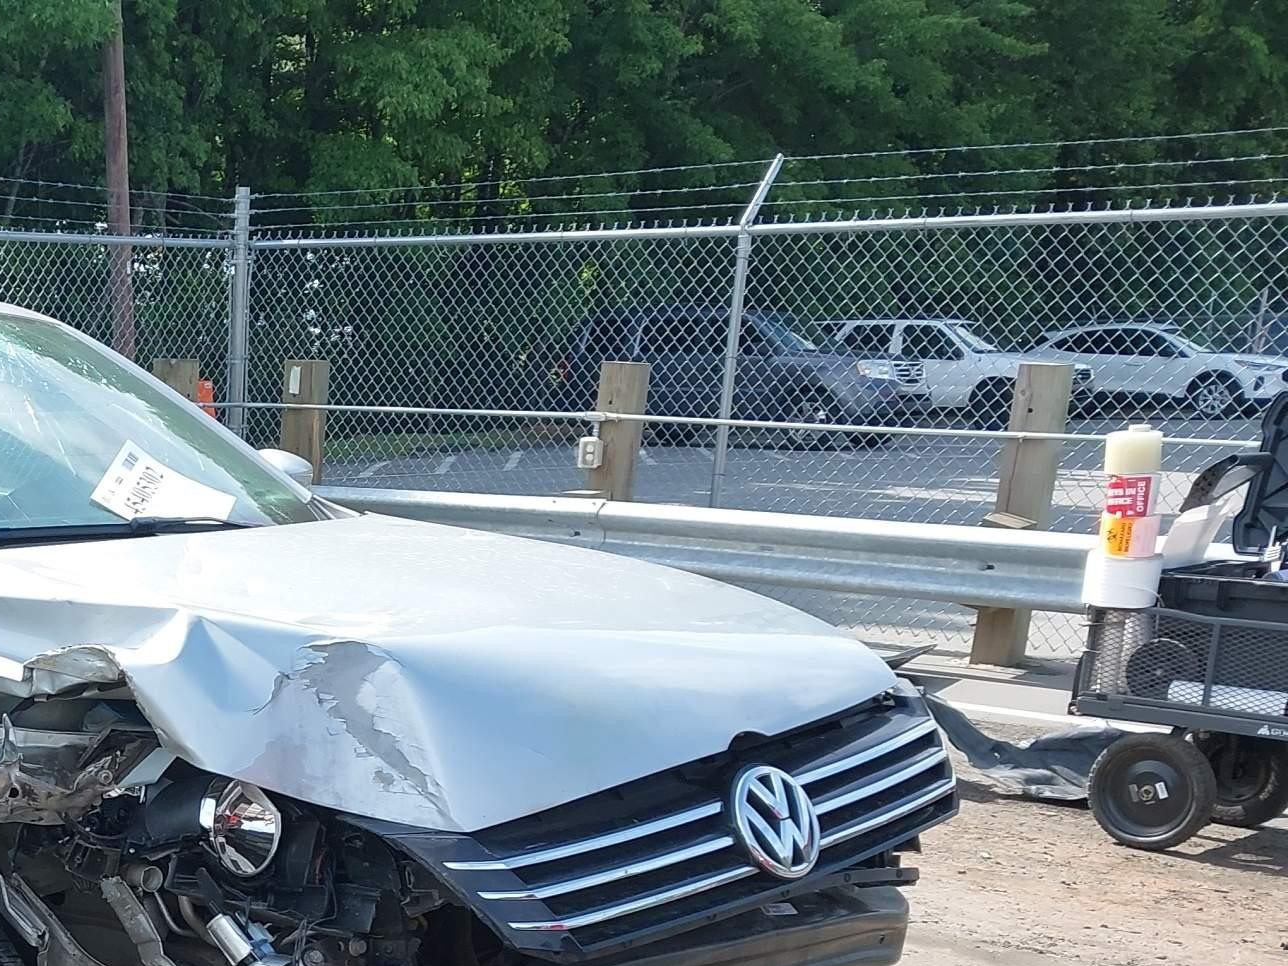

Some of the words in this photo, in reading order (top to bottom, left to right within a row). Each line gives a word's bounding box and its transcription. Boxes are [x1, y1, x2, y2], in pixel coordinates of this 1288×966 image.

[124, 466, 164, 514] 45405302
[1136, 481, 1146, 512] OFFICE
[738, 768, 818, 874] VW
